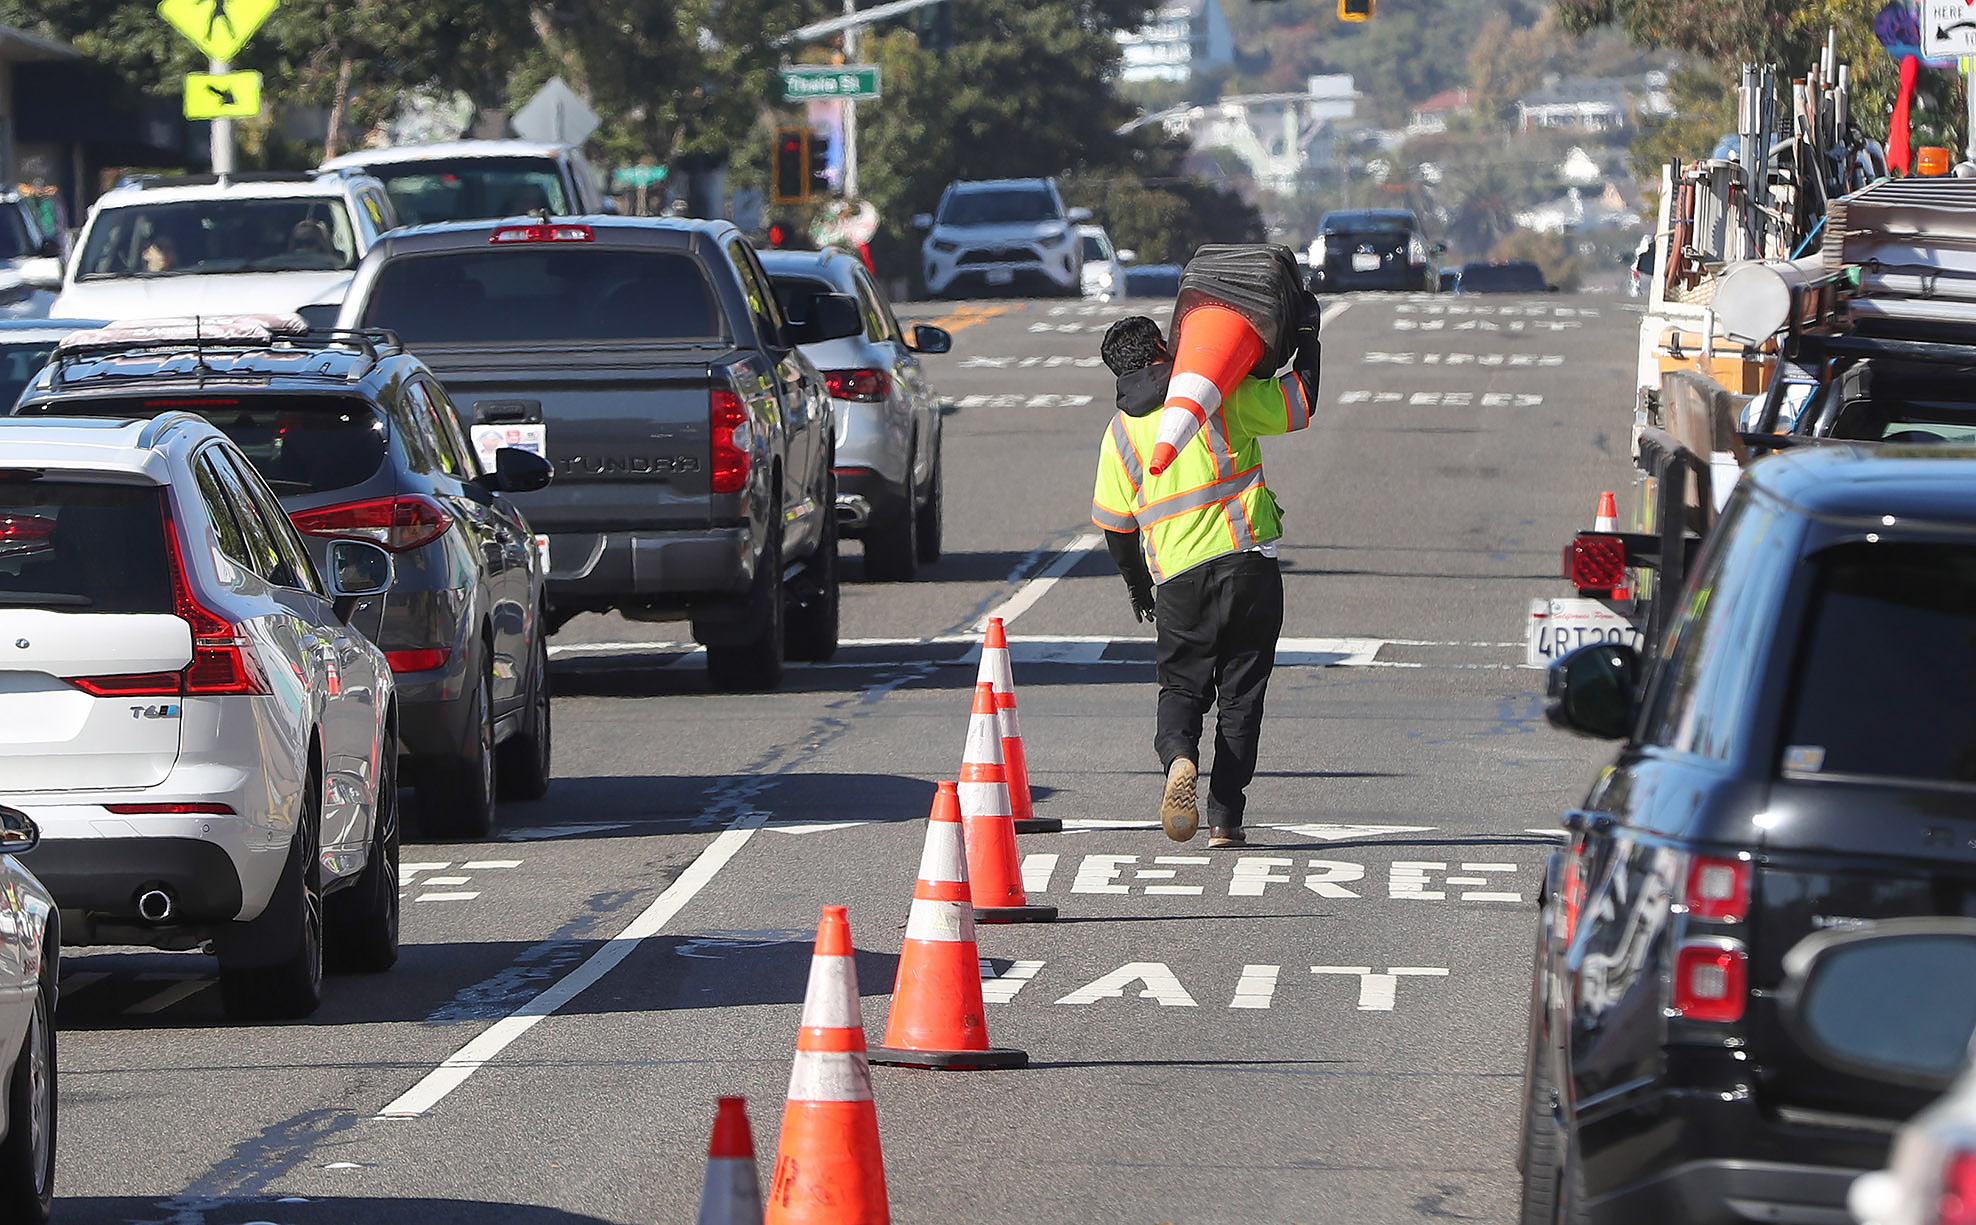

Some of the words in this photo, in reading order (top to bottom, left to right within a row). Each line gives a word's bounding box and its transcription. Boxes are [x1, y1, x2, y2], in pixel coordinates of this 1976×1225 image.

[1933, 5, 1963, 20] HERE
[957, 355, 1104, 369] XIN
[559, 455, 702, 475] TUNDRA
